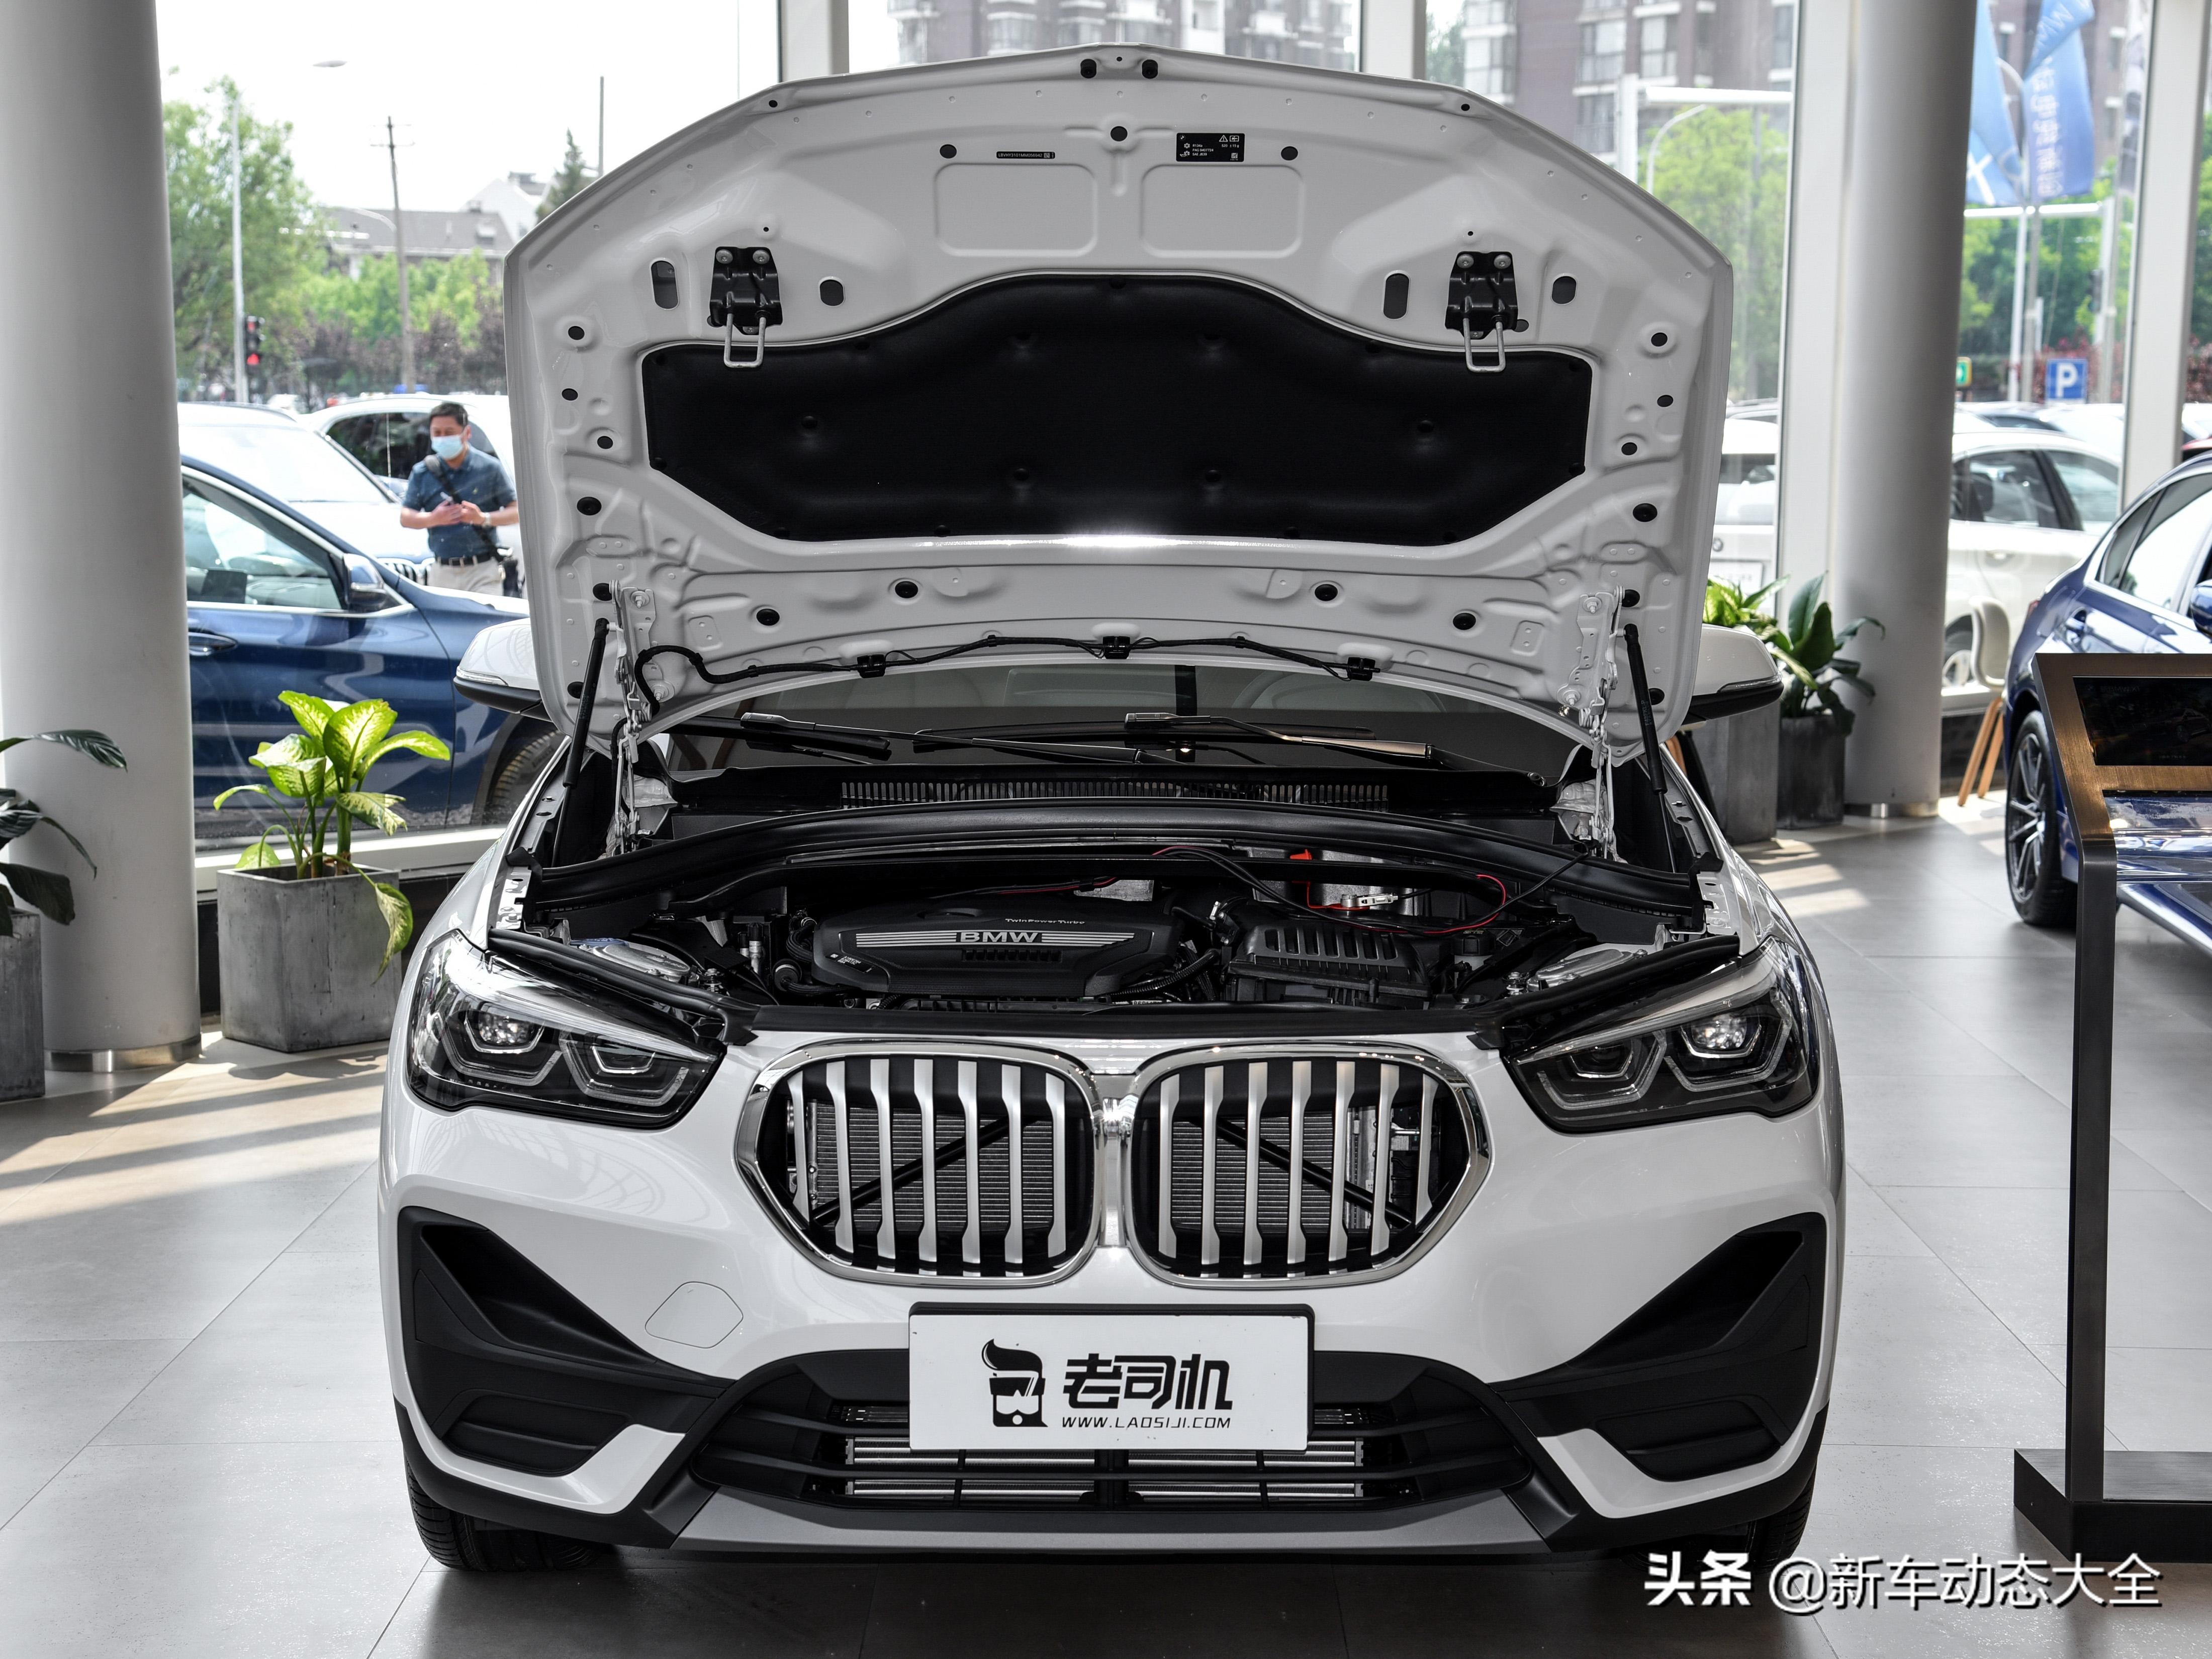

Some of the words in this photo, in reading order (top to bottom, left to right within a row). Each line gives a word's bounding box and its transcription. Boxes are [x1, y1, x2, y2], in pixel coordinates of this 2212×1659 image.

[2056, 362, 2078, 397] P
[960, 932, 1038, 943] BMW
[1063, 1353, 1233, 1410] 老司机
[1062, 1416, 1231, 1429] WWW.LAOSIJI.COM
